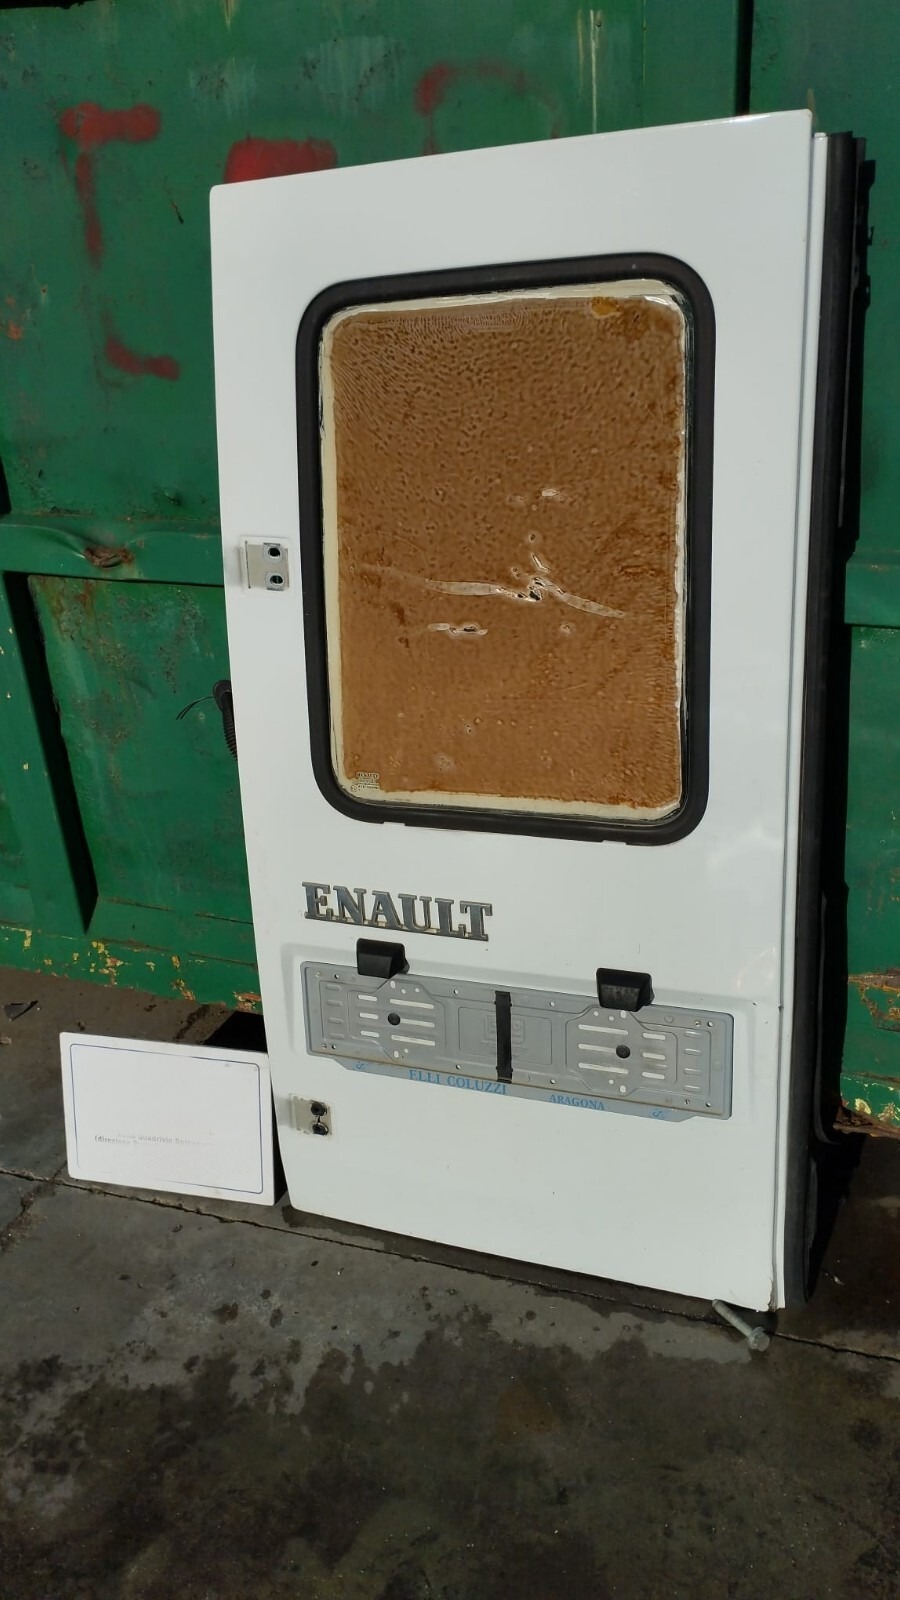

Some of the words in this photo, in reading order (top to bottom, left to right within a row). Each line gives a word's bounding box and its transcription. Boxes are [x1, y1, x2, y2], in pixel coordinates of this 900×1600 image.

[302, 881, 493, 942] ENAULT
[446, 1075, 508, 1095] COLUZZI
[549, 1093, 605, 1111] ARAGONA
